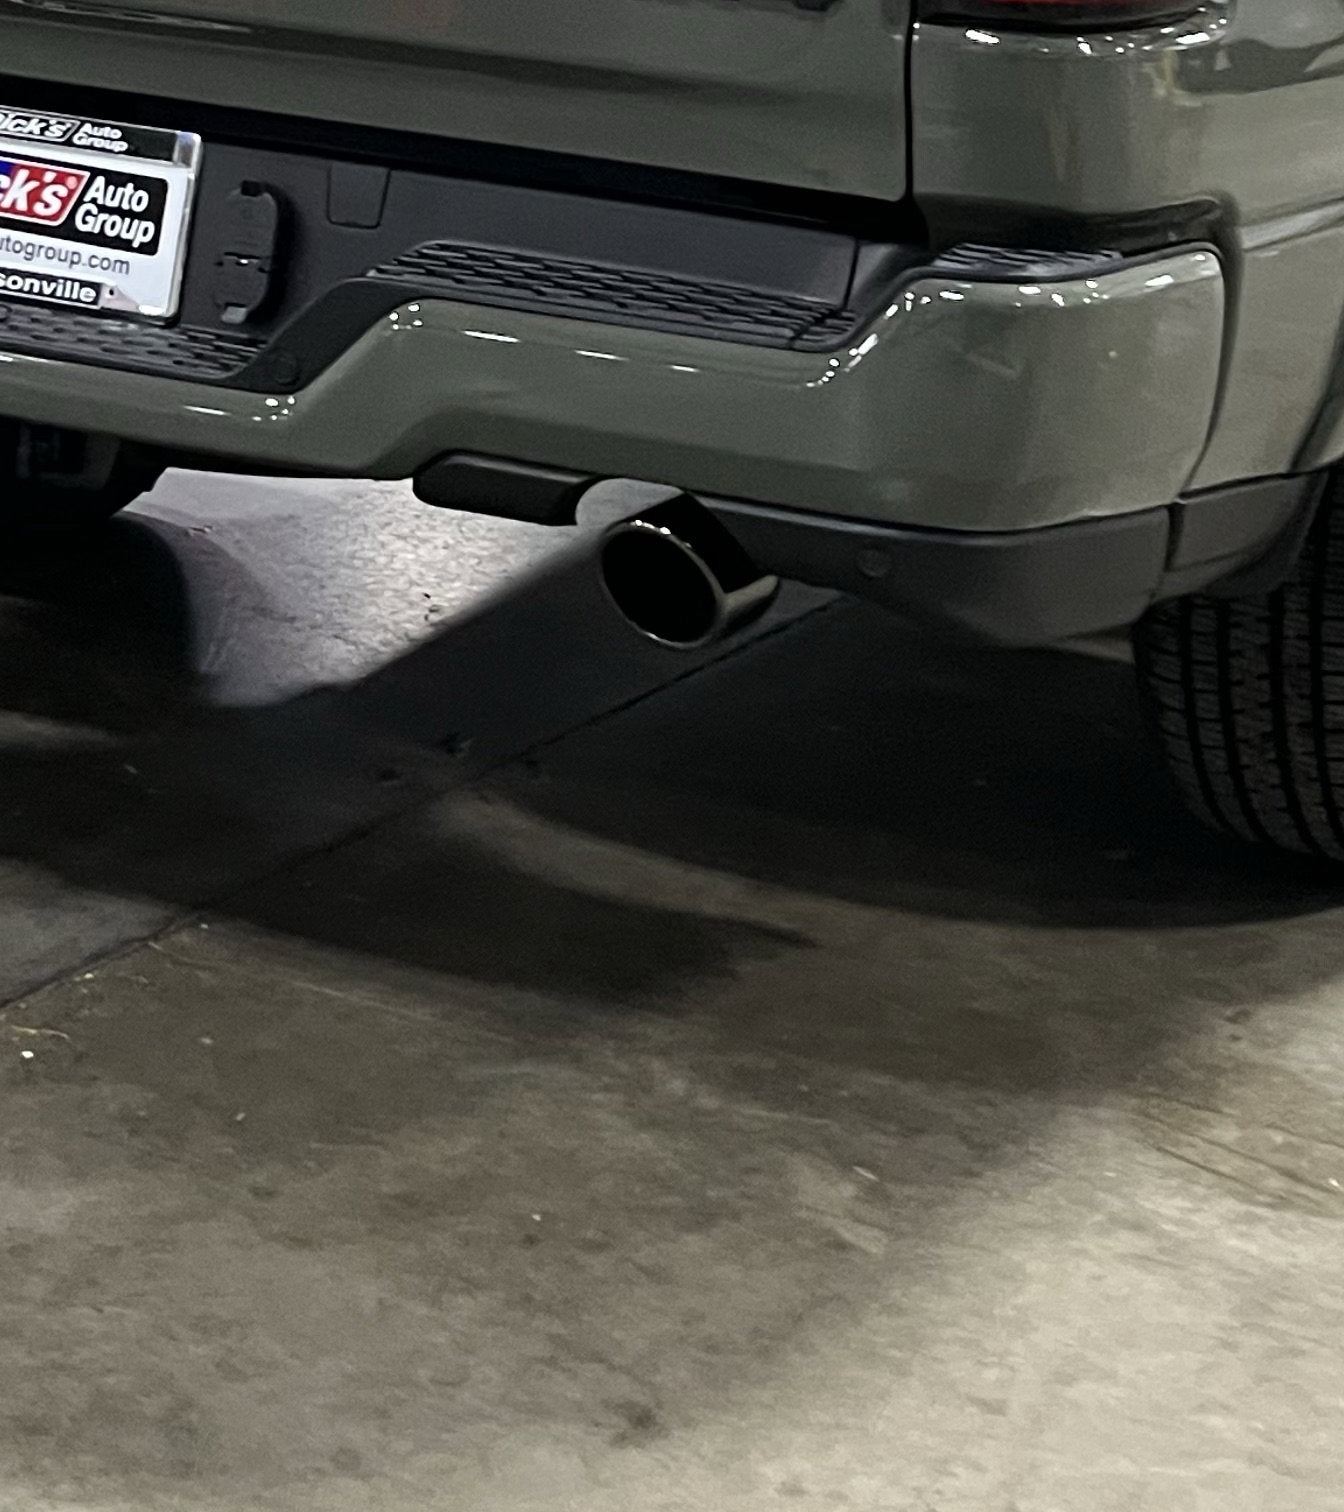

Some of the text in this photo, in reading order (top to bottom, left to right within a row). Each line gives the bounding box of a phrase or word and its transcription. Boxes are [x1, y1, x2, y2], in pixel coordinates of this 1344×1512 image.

[72, 132, 129, 153] Group
[80, 122, 123, 140] Auto
[83, 175, 149, 212] Auto
[75, 202, 155, 248] Group
